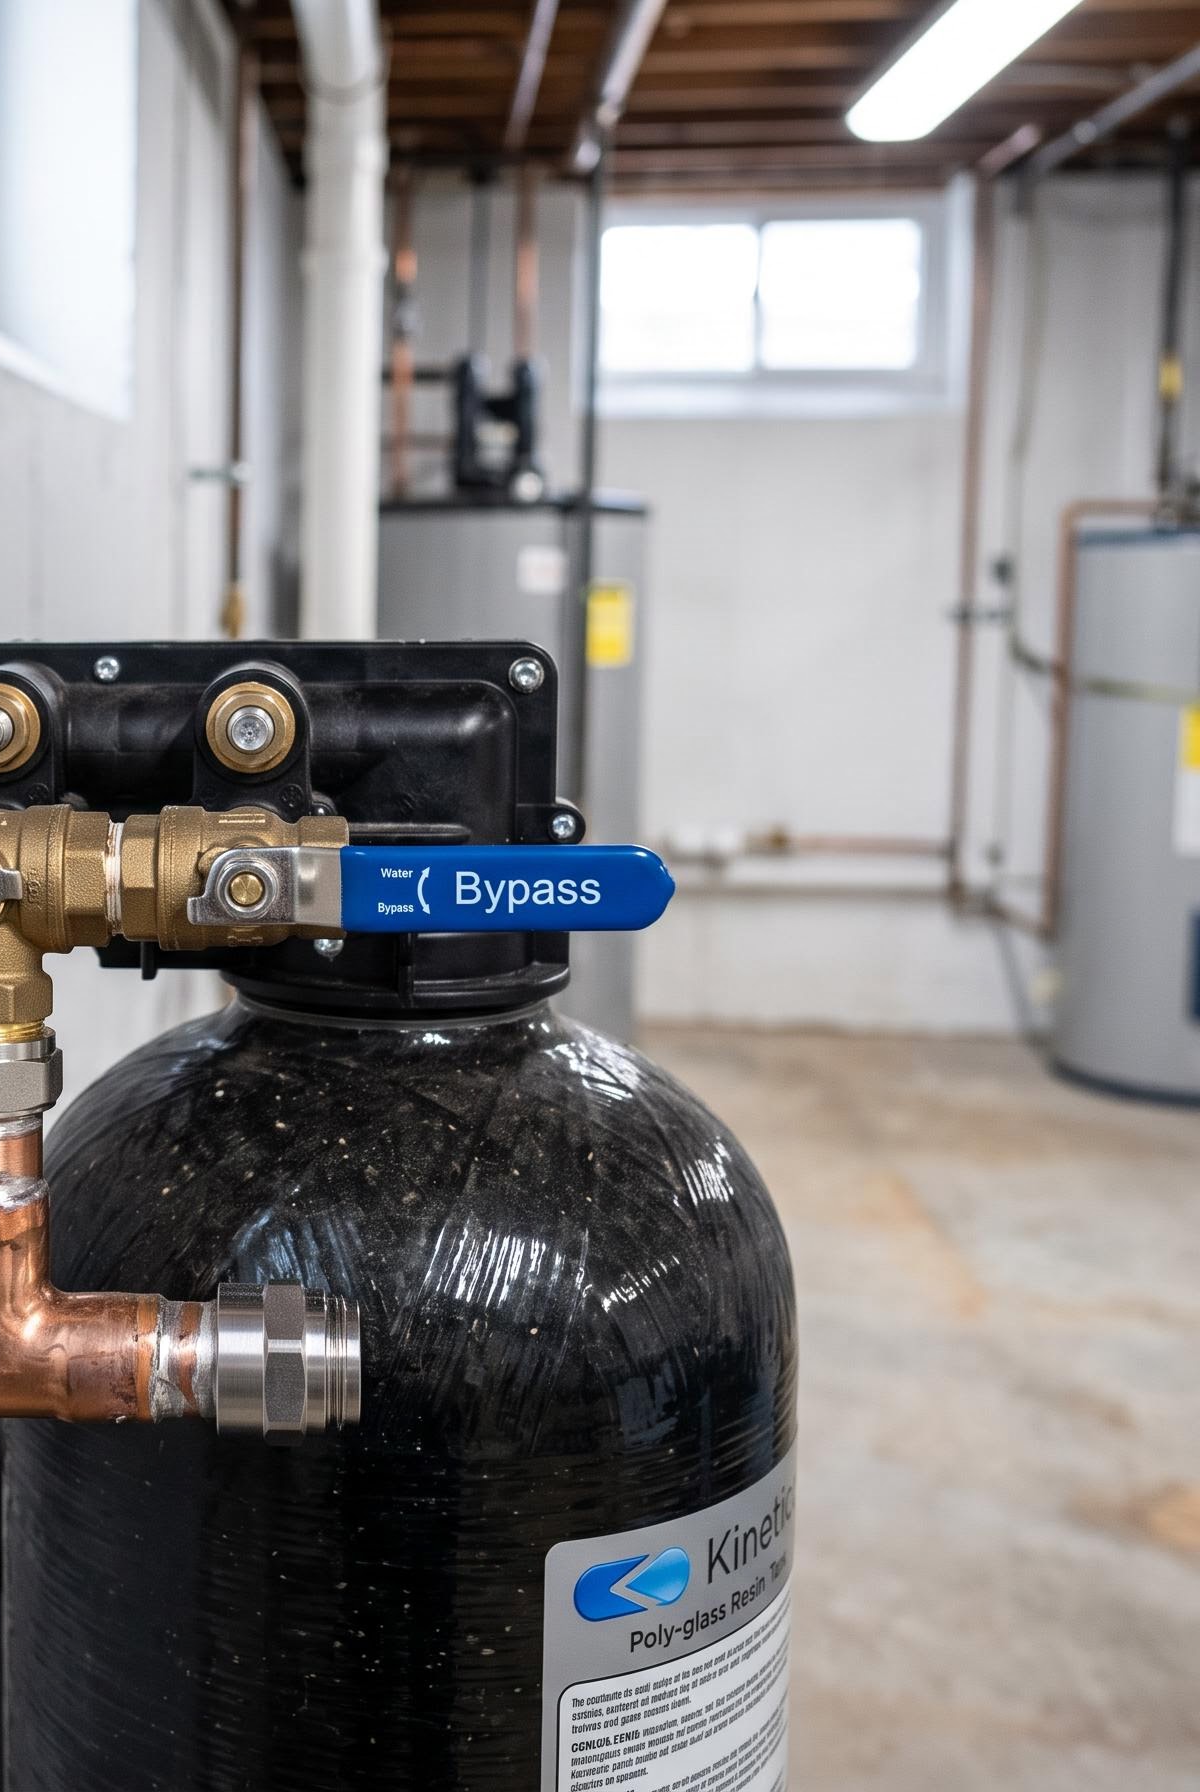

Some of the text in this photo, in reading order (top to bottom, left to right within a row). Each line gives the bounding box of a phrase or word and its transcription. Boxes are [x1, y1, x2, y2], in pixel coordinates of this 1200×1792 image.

[381, 868, 413, 878] Water
[455, 871, 601, 914] Bypass
[378, 902, 414, 915] Bypass
[707, 1486, 794, 1584] Kinetic
[630, 1603, 726, 1653] Poly-glass
[731, 1576, 765, 1615] Resin
